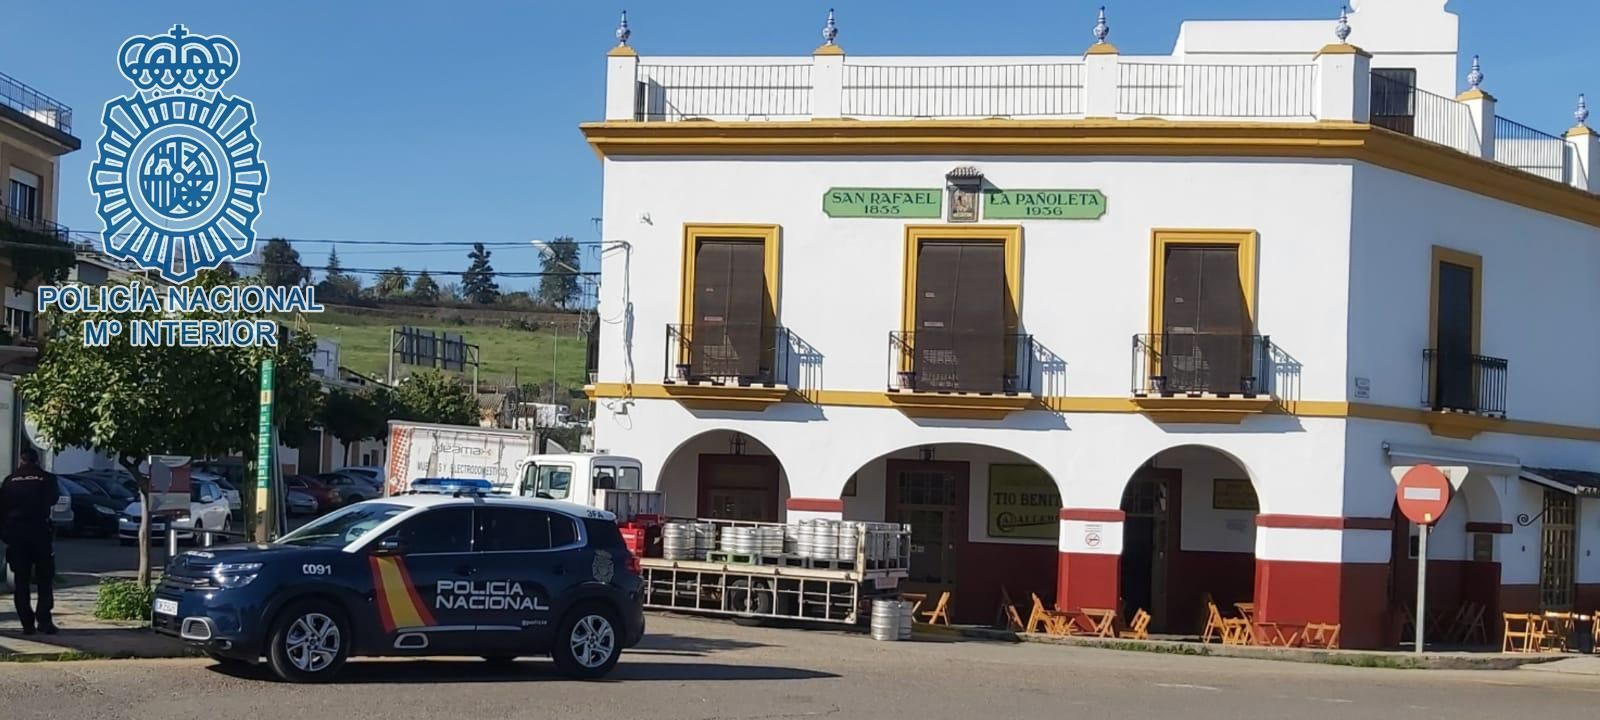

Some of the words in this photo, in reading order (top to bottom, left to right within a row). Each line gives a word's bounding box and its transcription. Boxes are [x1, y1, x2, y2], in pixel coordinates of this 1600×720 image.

[832, 192, 865, 204] SAN
[870, 192, 936, 204] RAFAEL
[990, 193, 1011, 205] LA
[1016, 192, 1098, 206] PAÑOLETA
[993, 492, 1016, 505] TIO
[1021, 492, 1061, 507] BENIT
[437, 579, 524, 596] POLICÍA
[436, 596, 549, 611] NACIONAL
